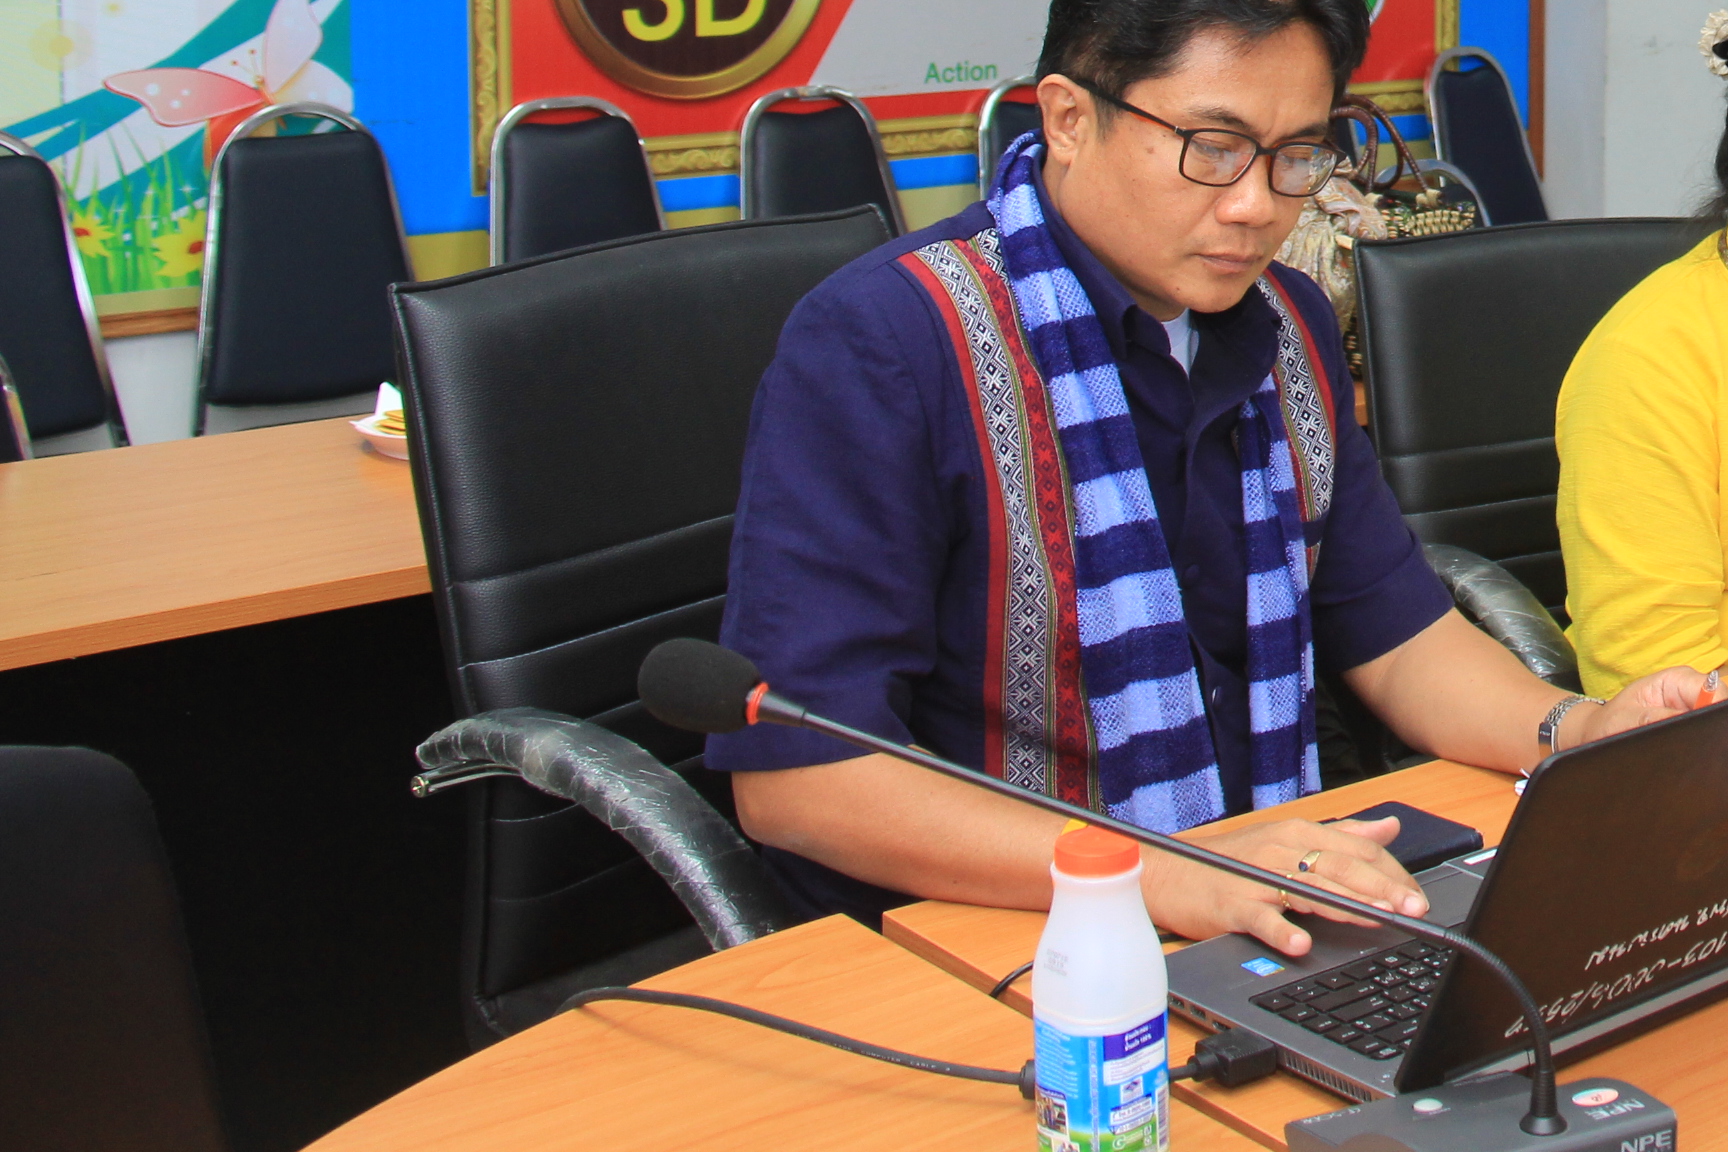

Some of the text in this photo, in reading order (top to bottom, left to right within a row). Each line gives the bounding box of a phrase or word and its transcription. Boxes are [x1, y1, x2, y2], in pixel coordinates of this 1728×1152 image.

[923, 61, 997, 85] Action
[1588, 1098, 1646, 1121] NPE
[1620, 1129, 1673, 1152] NPE
